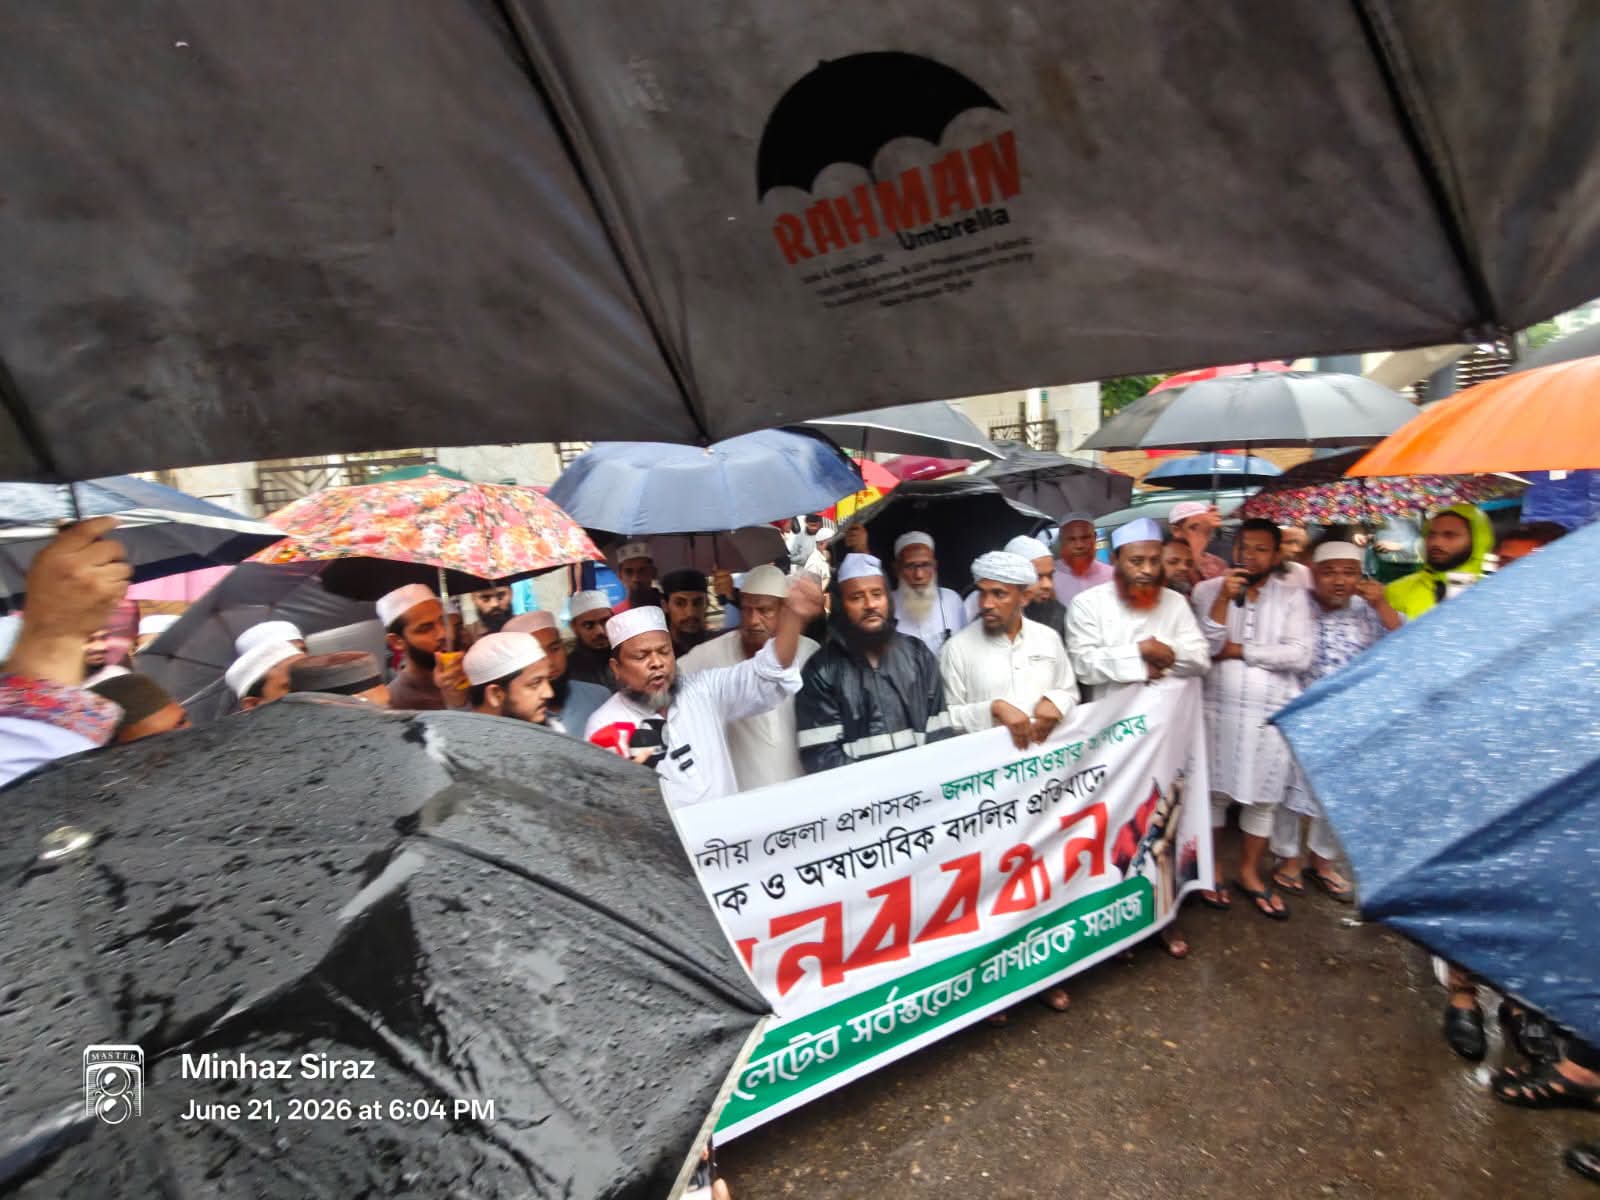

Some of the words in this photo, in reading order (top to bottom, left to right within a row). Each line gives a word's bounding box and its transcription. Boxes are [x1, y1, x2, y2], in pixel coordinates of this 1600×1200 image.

[772, 130, 1021, 267] RAHMAN
[896, 207, 1010, 251] Umbrella
[694, 837, 752, 871] নীয়
[764, 817, 827, 857] জেলা
[836, 790, 932, 832] প্রশাসক-
[941, 768, 998, 800] জনাব
[1003, 741, 1084, 784] সারওয়ার
[712, 883, 749, 915] ক
[761, 874, 785, 899] ও
[795, 826, 936, 887] অস্বাভাবিক
[943, 800, 1018, 841] বদলির
[732, 1024, 842, 1100] লেটের
[846, 986, 976, 1042] সর্বস্তরের
[980, 919, 1076, 986] নাগরিক
[1083, 890, 1143, 938] সমাজ
